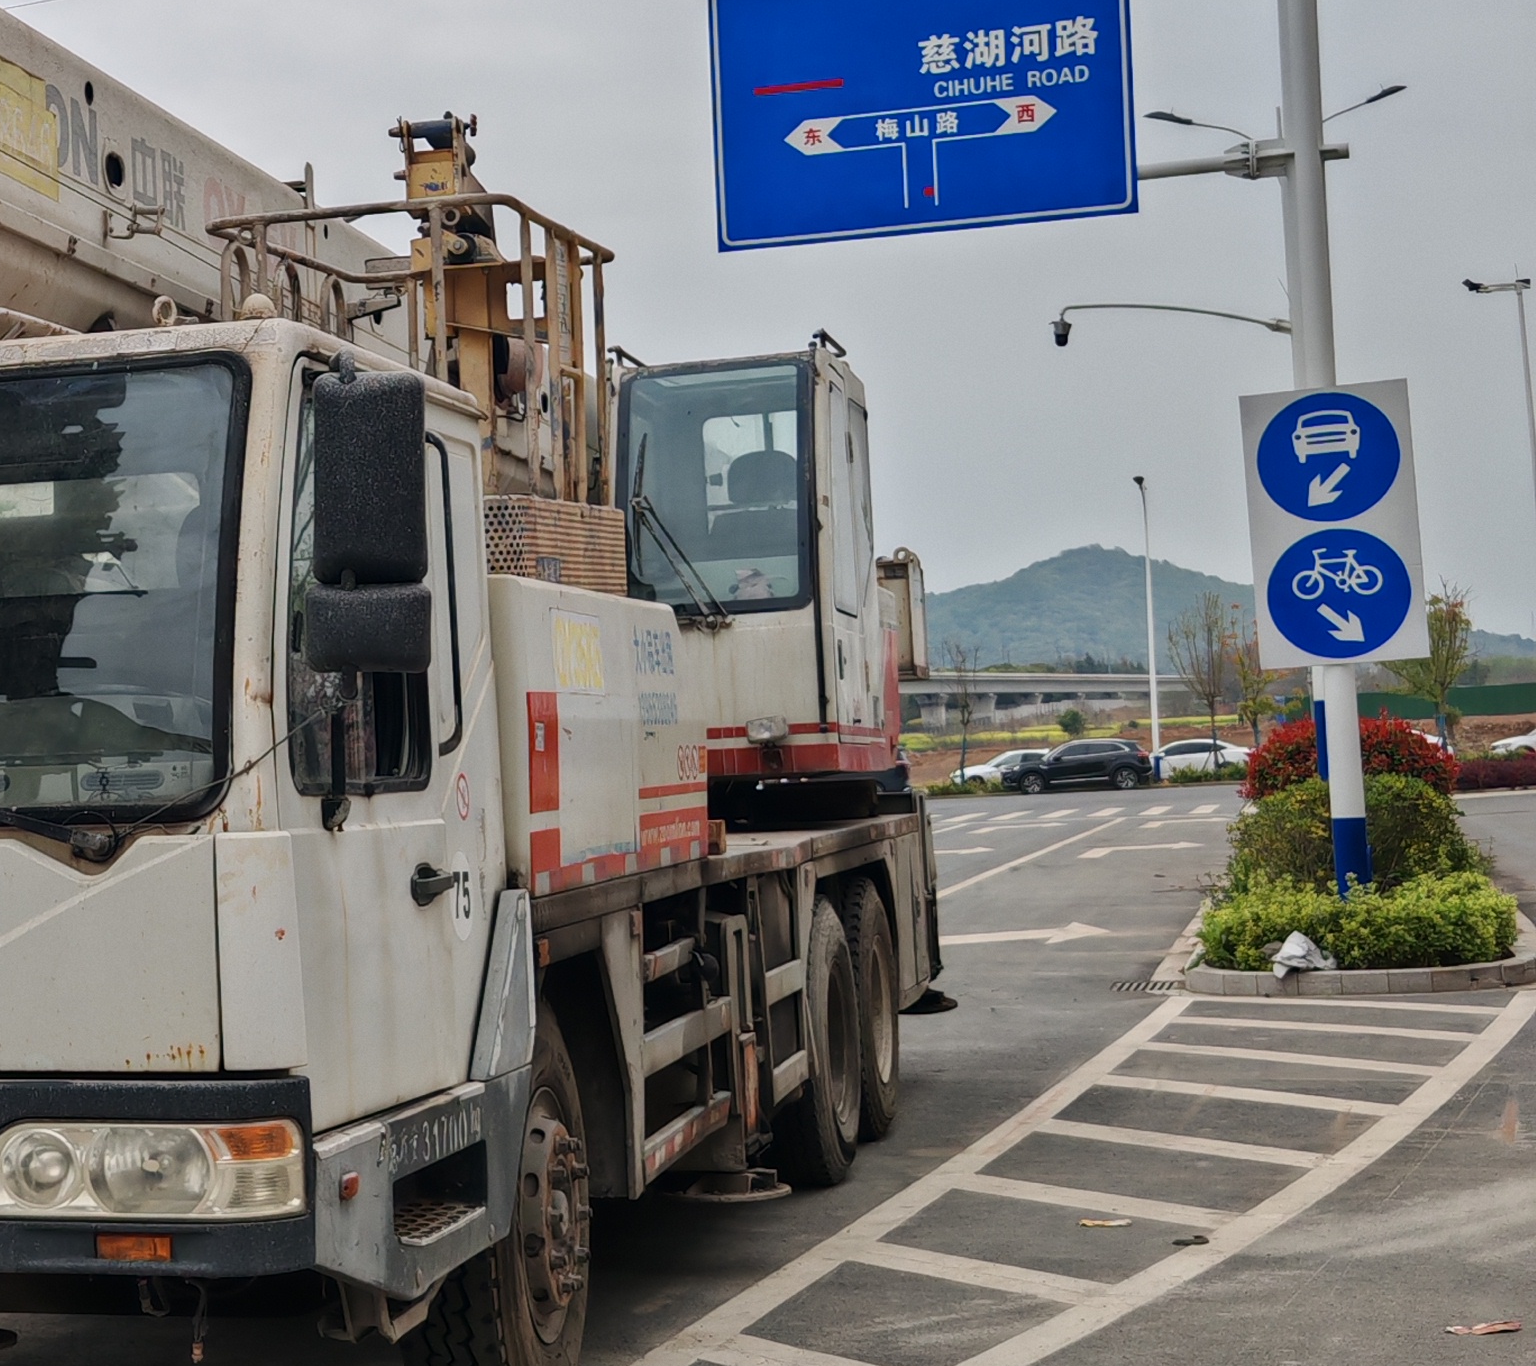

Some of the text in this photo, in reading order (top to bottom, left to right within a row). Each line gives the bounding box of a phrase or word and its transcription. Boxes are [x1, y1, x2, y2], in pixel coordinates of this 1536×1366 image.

[918, 15, 1099, 75] 慈湖河路
[933, 65, 1090, 98] CIHUHE ROAD
[875, 111, 960, 142] 梅山路
[1015, 103, 1036, 124] 西
[803, 128, 823, 147] 东
[130, 136, 186, 232] 中联
[452, 871, 471, 920] 75
